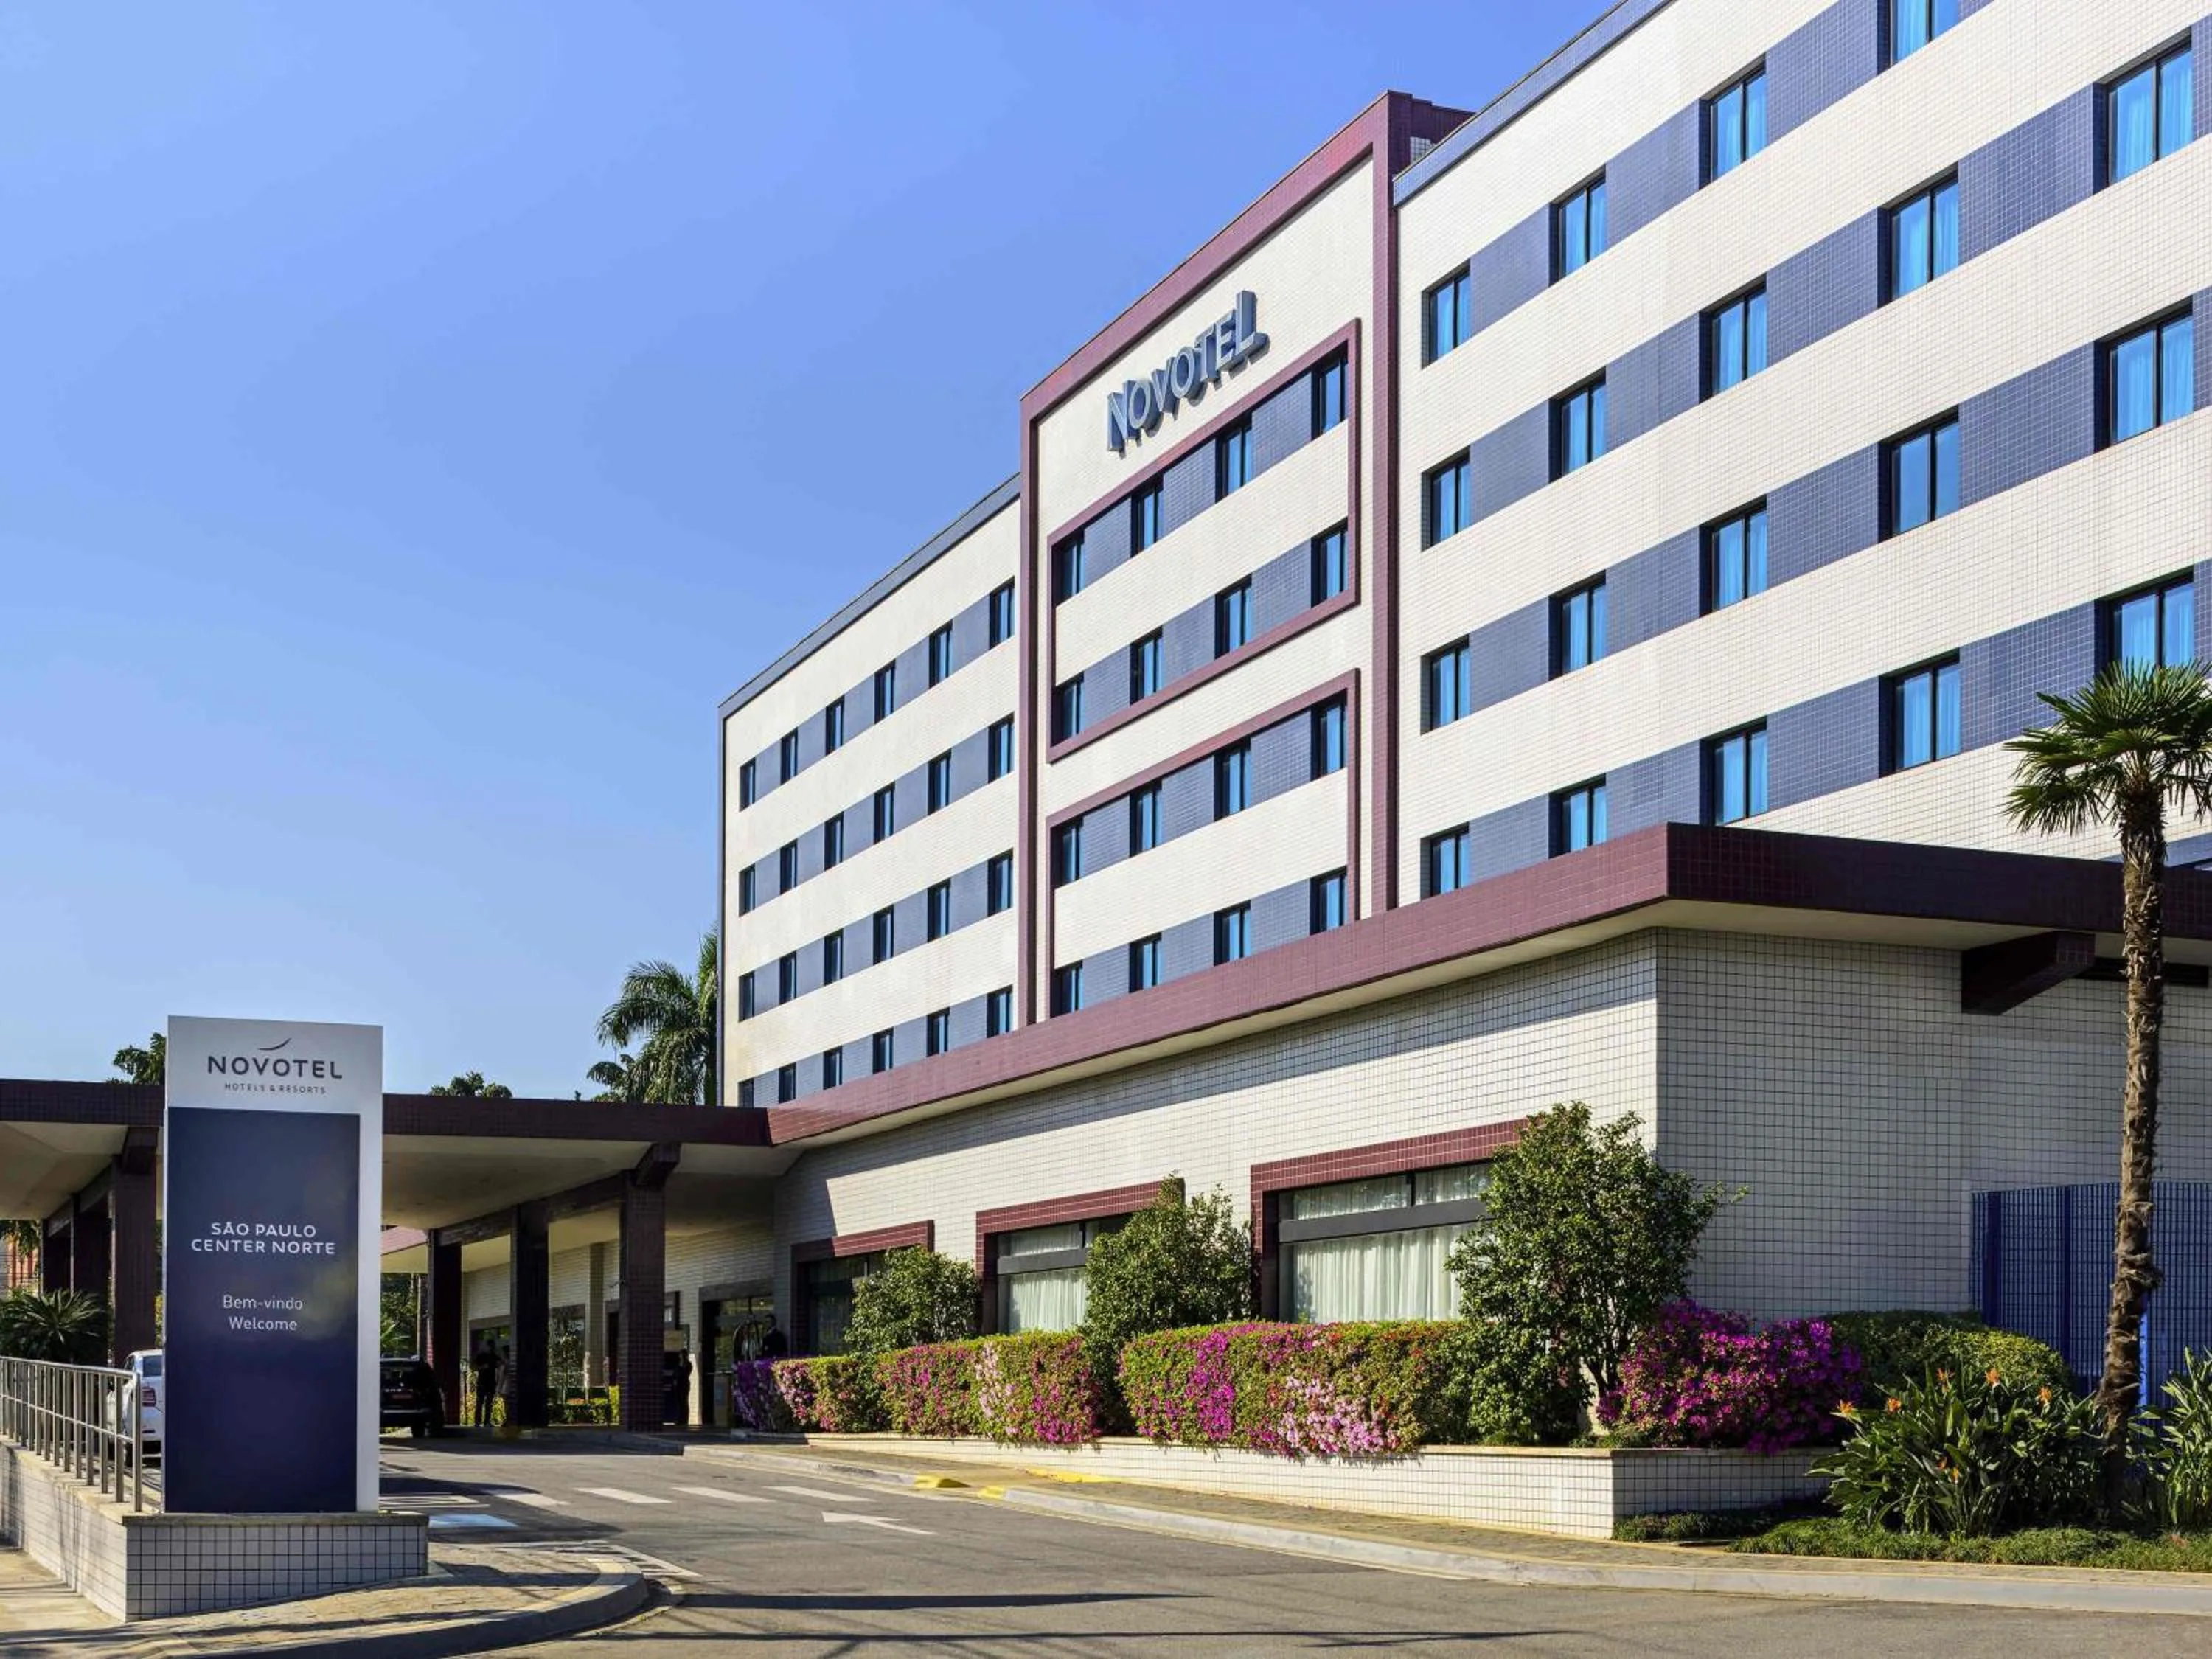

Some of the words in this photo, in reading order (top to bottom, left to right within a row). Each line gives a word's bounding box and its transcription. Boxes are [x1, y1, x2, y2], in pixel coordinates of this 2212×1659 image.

[1107, 290, 1269, 452] NOVOTEL
[207, 1055, 343, 1079] NOVOTEL
[225, 1082, 265, 1092] HOTELS
[269, 1084, 276, 1092] &
[279, 1085, 326, 1094] RESORTS
[211, 1222, 249, 1236] SÃO
[256, 1224, 316, 1238] PAULO
[191, 1239, 265, 1253] CENTER
[272, 1242, 335, 1254] NORTE
[223, 1295, 303, 1310] Bem-vindo
[229, 1316, 297, 1330] Welcome
